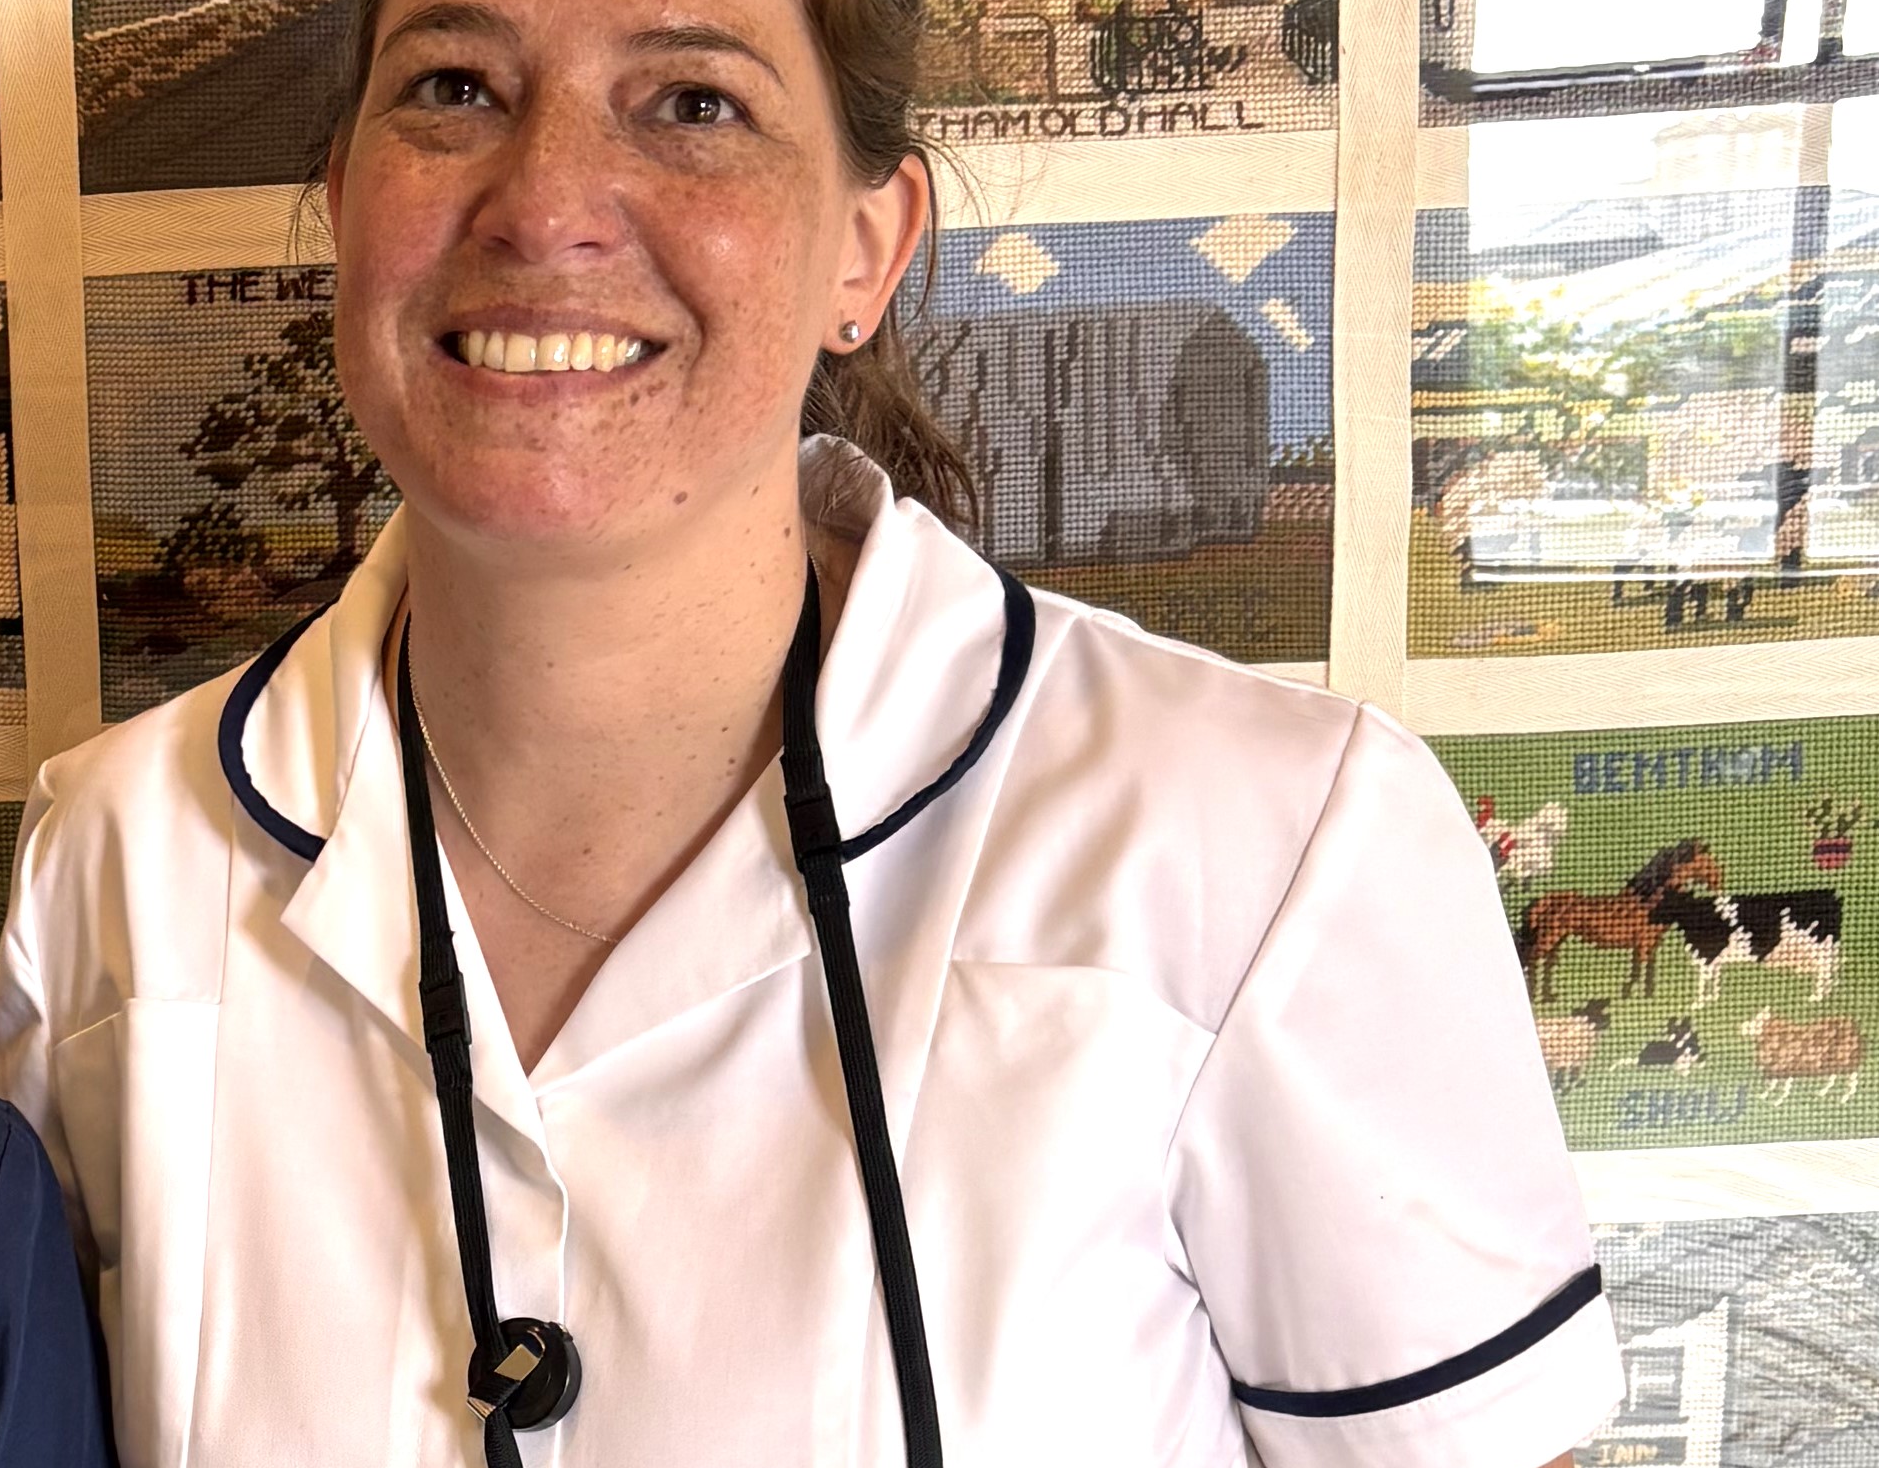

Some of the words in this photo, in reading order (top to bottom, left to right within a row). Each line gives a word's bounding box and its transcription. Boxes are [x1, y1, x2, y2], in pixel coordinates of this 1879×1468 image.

[1038, 106, 1130, 137] OLD
[1137, 100, 1265, 132] HALL
[180, 271, 265, 305] THE
